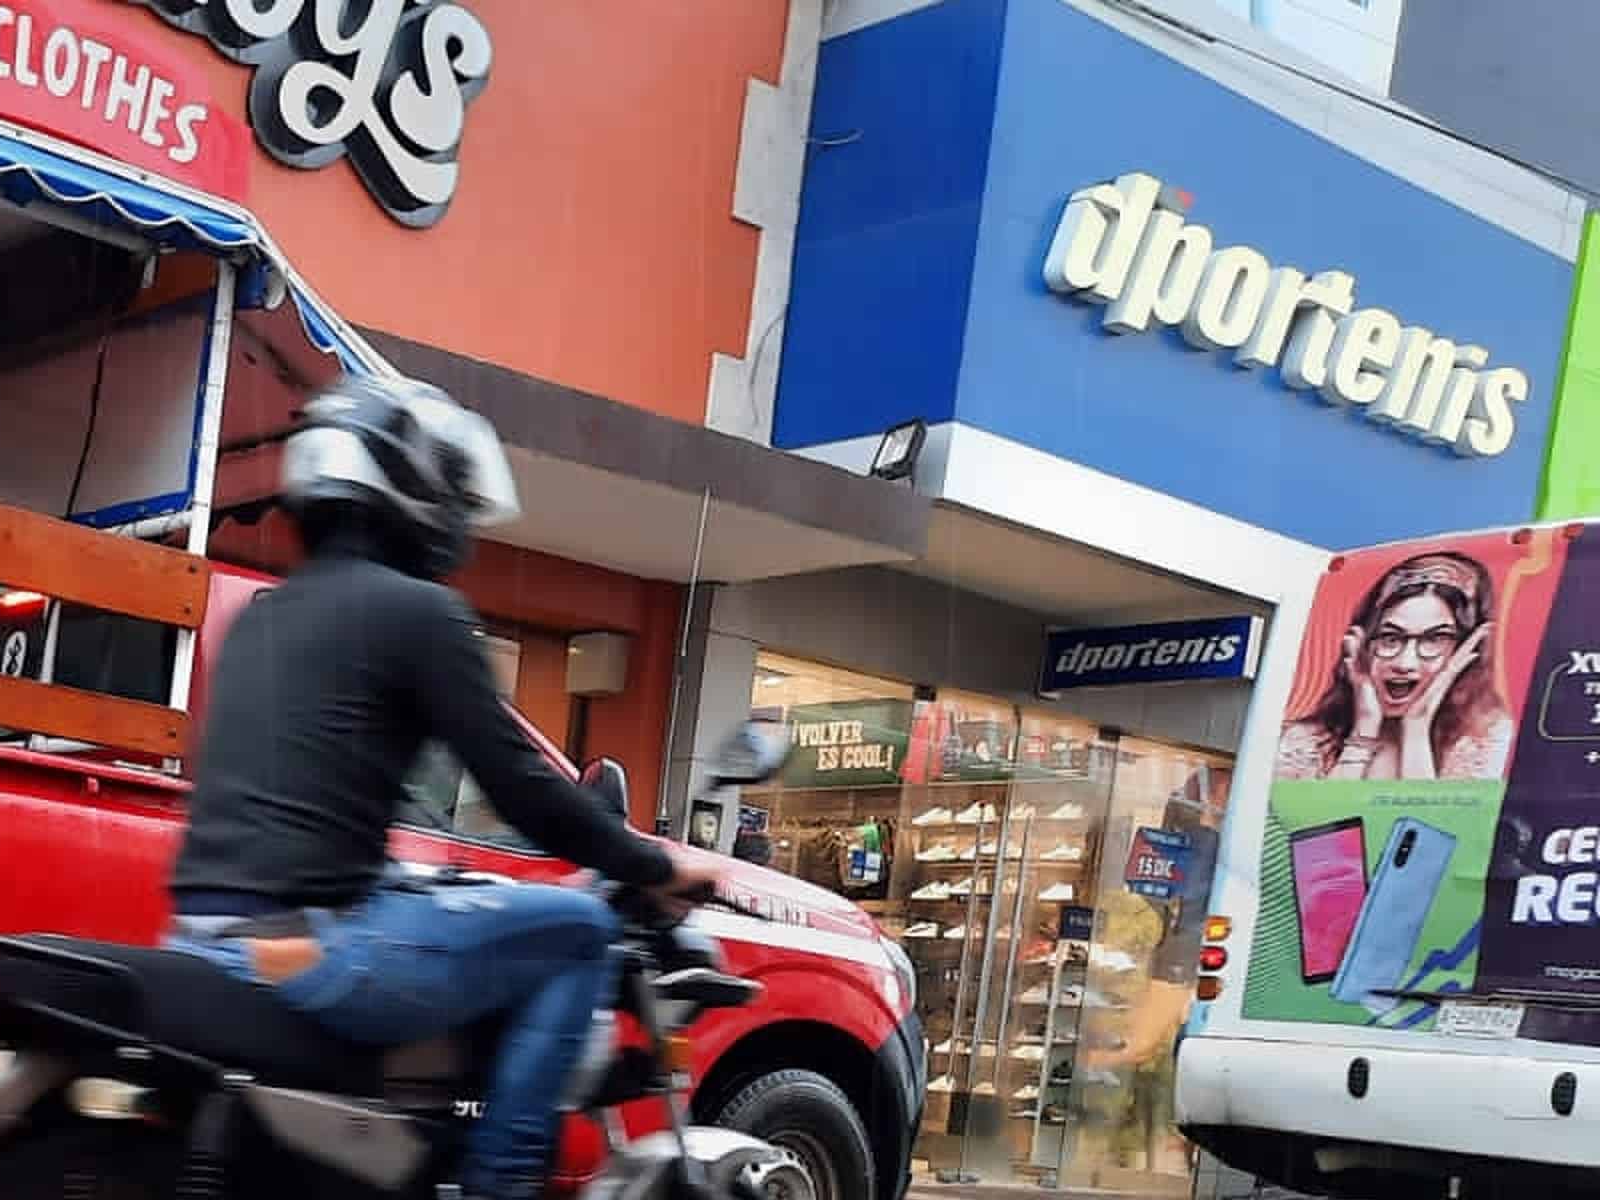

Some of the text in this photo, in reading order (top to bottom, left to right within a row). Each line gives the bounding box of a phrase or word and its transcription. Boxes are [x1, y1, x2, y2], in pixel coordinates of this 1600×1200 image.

[1045, 172, 1529, 456] dportenis
[1056, 634, 1241, 675] dportenis
[816, 746, 839, 771] ES
[1542, 826, 1600, 864] CE
